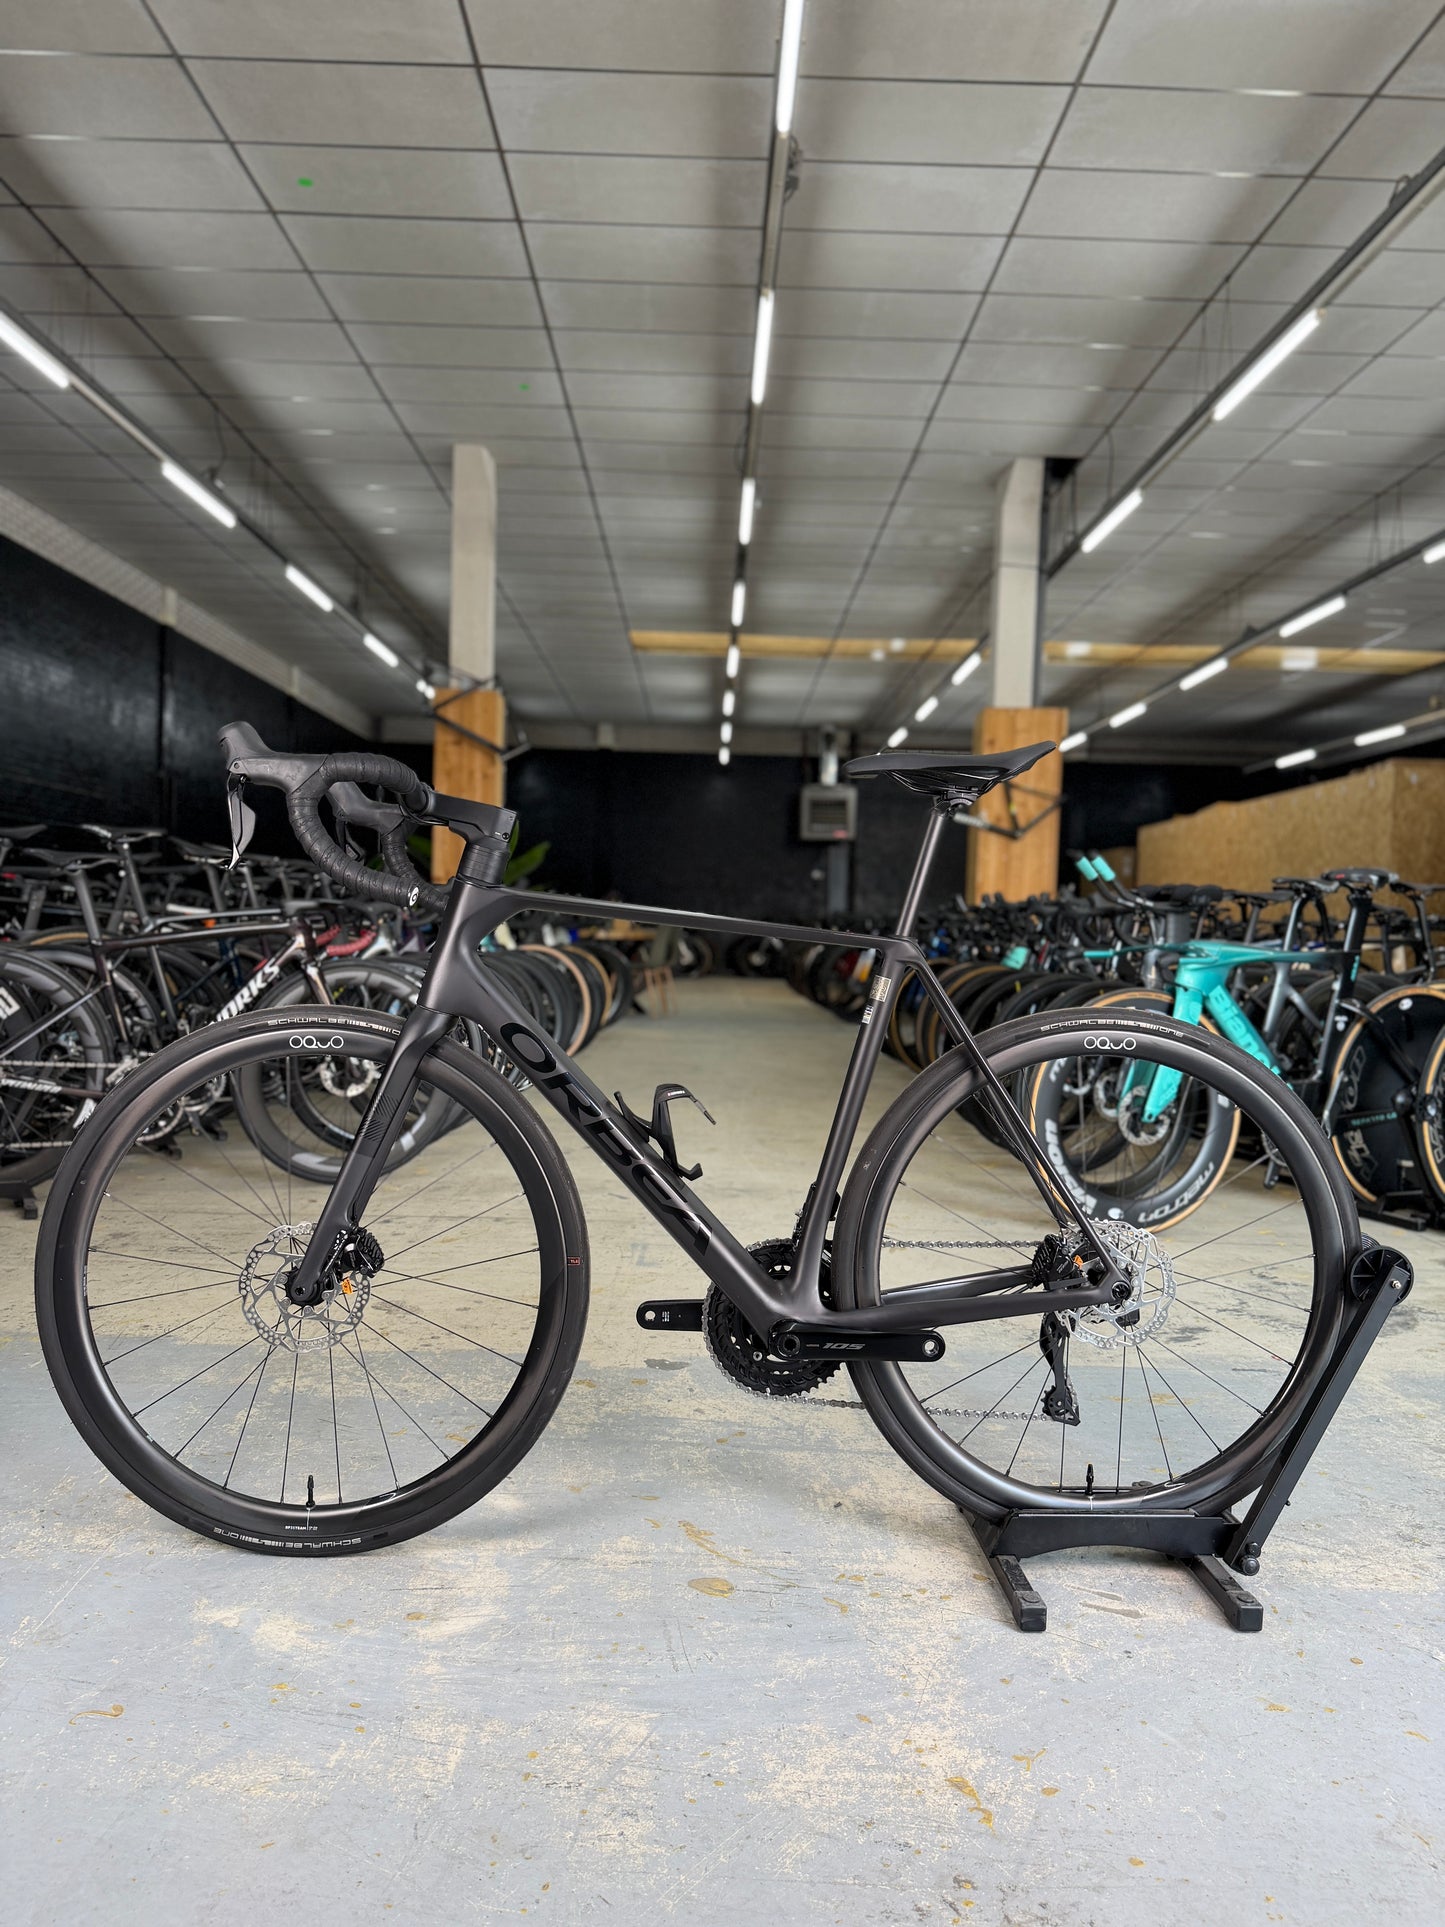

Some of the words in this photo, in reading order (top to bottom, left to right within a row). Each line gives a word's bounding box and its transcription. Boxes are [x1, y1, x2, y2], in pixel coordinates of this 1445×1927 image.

[215, 957, 279, 1022] ORKS
[267, 1017, 347, 1026] SCHWALBE
[1040, 1018, 1114, 1031] SCHWALBE
[1158, 1026, 1184, 1037] ONE
[289, 1035, 344, 1049] OQUO
[1083, 1036, 1136, 1050] OQUO
[500, 1022, 713, 1257] ORBEA
[823, 1342, 866, 1350] 105
[285, 1537, 362, 1549] SCHWALBE
